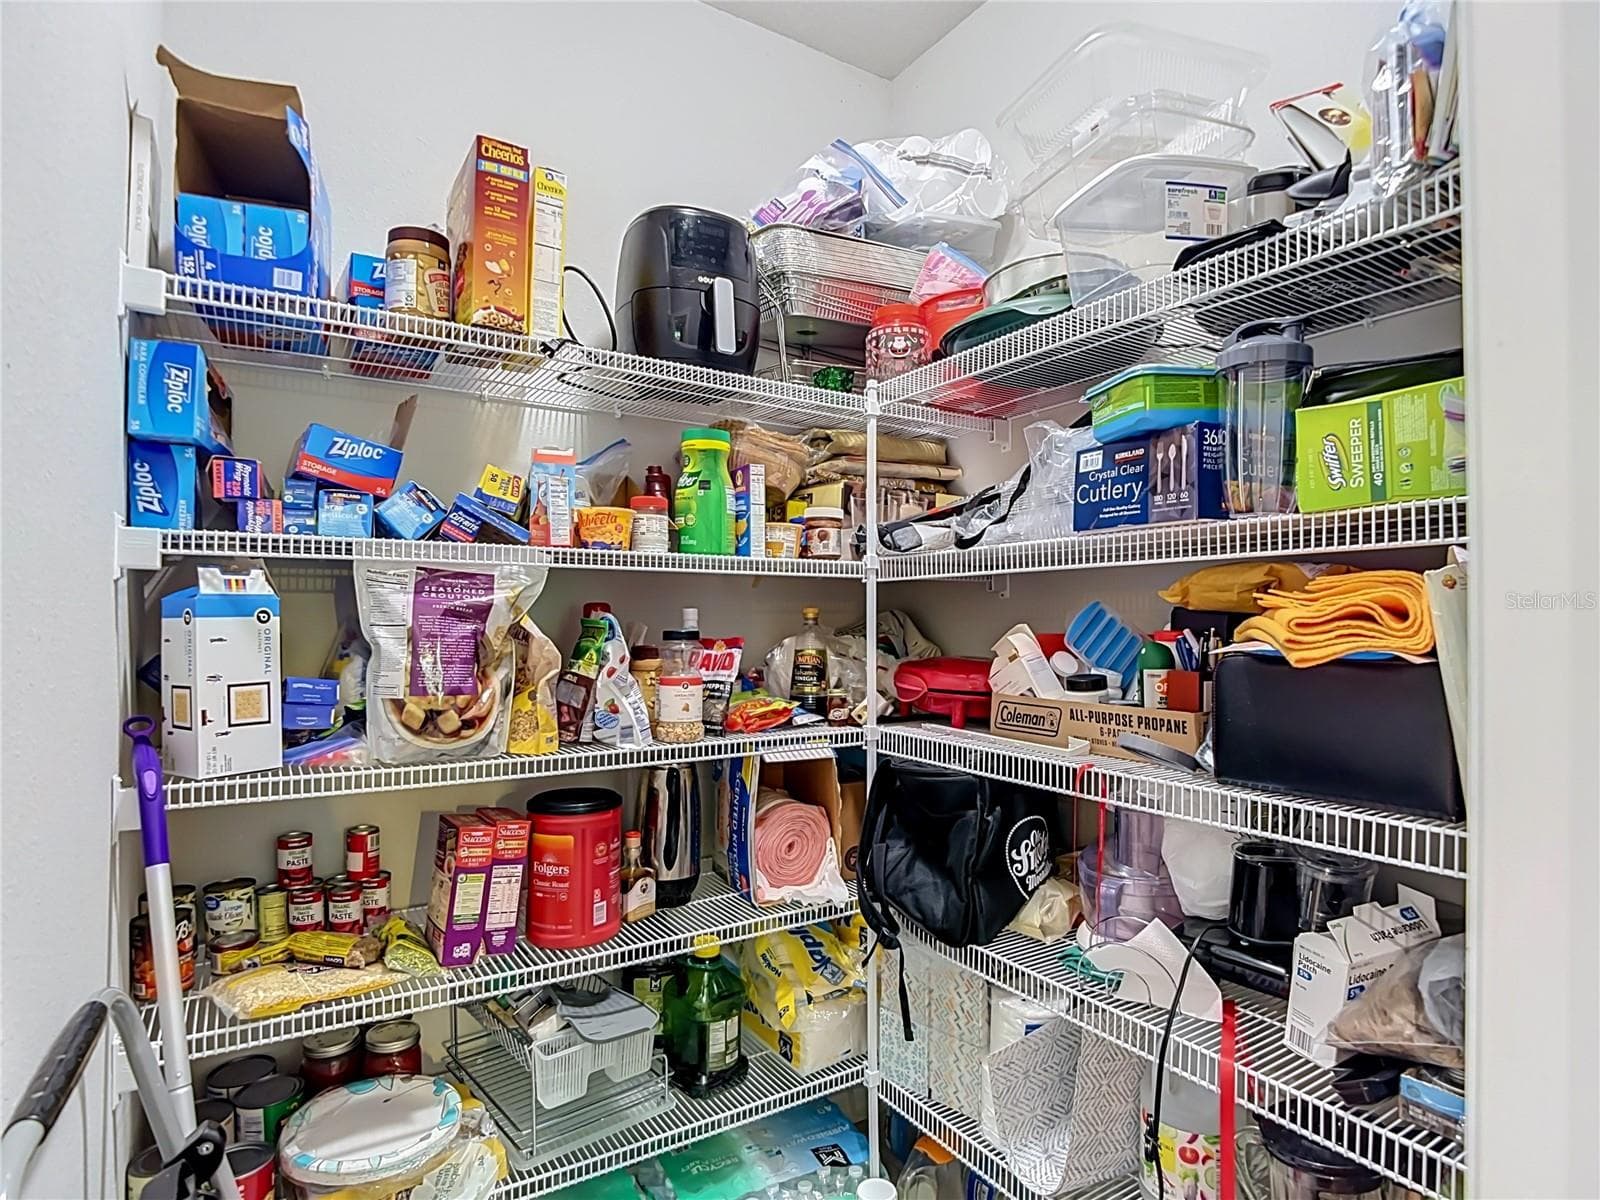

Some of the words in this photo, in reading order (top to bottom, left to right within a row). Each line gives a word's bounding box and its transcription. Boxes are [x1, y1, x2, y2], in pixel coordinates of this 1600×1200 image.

[481, 143, 524, 166] Cheerios
[166, 366, 188, 415] Ziploc
[328, 436, 384, 460] Ziploc
[1114, 447, 1145, 459] KIRKLAND
[1349, 418, 1365, 488] SWEEPER
[302, 459, 338, 476] STORAGE
[1324, 435, 1347, 488] Swiffer
[243, 465, 252, 497] Reynolds
[490, 474, 499, 482] 50
[1088, 467, 1122, 482] Crystal
[1123, 463, 1144, 477] Clear
[1372, 472, 1383, 486] 40
[133, 462, 163, 514] Ziploc
[511, 476, 521, 497] GLAD
[1076, 480, 1143, 505] Cutlery
[1180, 491, 1189, 500] 60
[1167, 493, 1177, 502] 120
[423, 585, 485, 595] SEASONED
[263, 628, 272, 675] ORIGINAL
[689, 651, 735, 672] DAVID
[1000, 705, 1046, 727] Coleman
[1069, 707, 1134, 728] ALL-PURPOSE
[1137, 716, 1188, 735] PROPANE
[732, 771, 742, 830] SCENTED
[463, 834, 492, 843] Success
[499, 827, 527, 835] Success
[286, 858, 309, 867] PASTE
[533, 861, 569, 877] Folgers
[732, 833, 741, 890] KITCHEN
[533, 879, 551, 887] Classic
[292, 914, 316, 922] PASTE
[331, 912, 353, 920] PASTE
[1369, 928, 1393, 943] Patch
[1391, 919, 1428, 937] Lidocaine
[1297, 960, 1318, 975] Patch
[1298, 952, 1332, 975] Lidocaine
